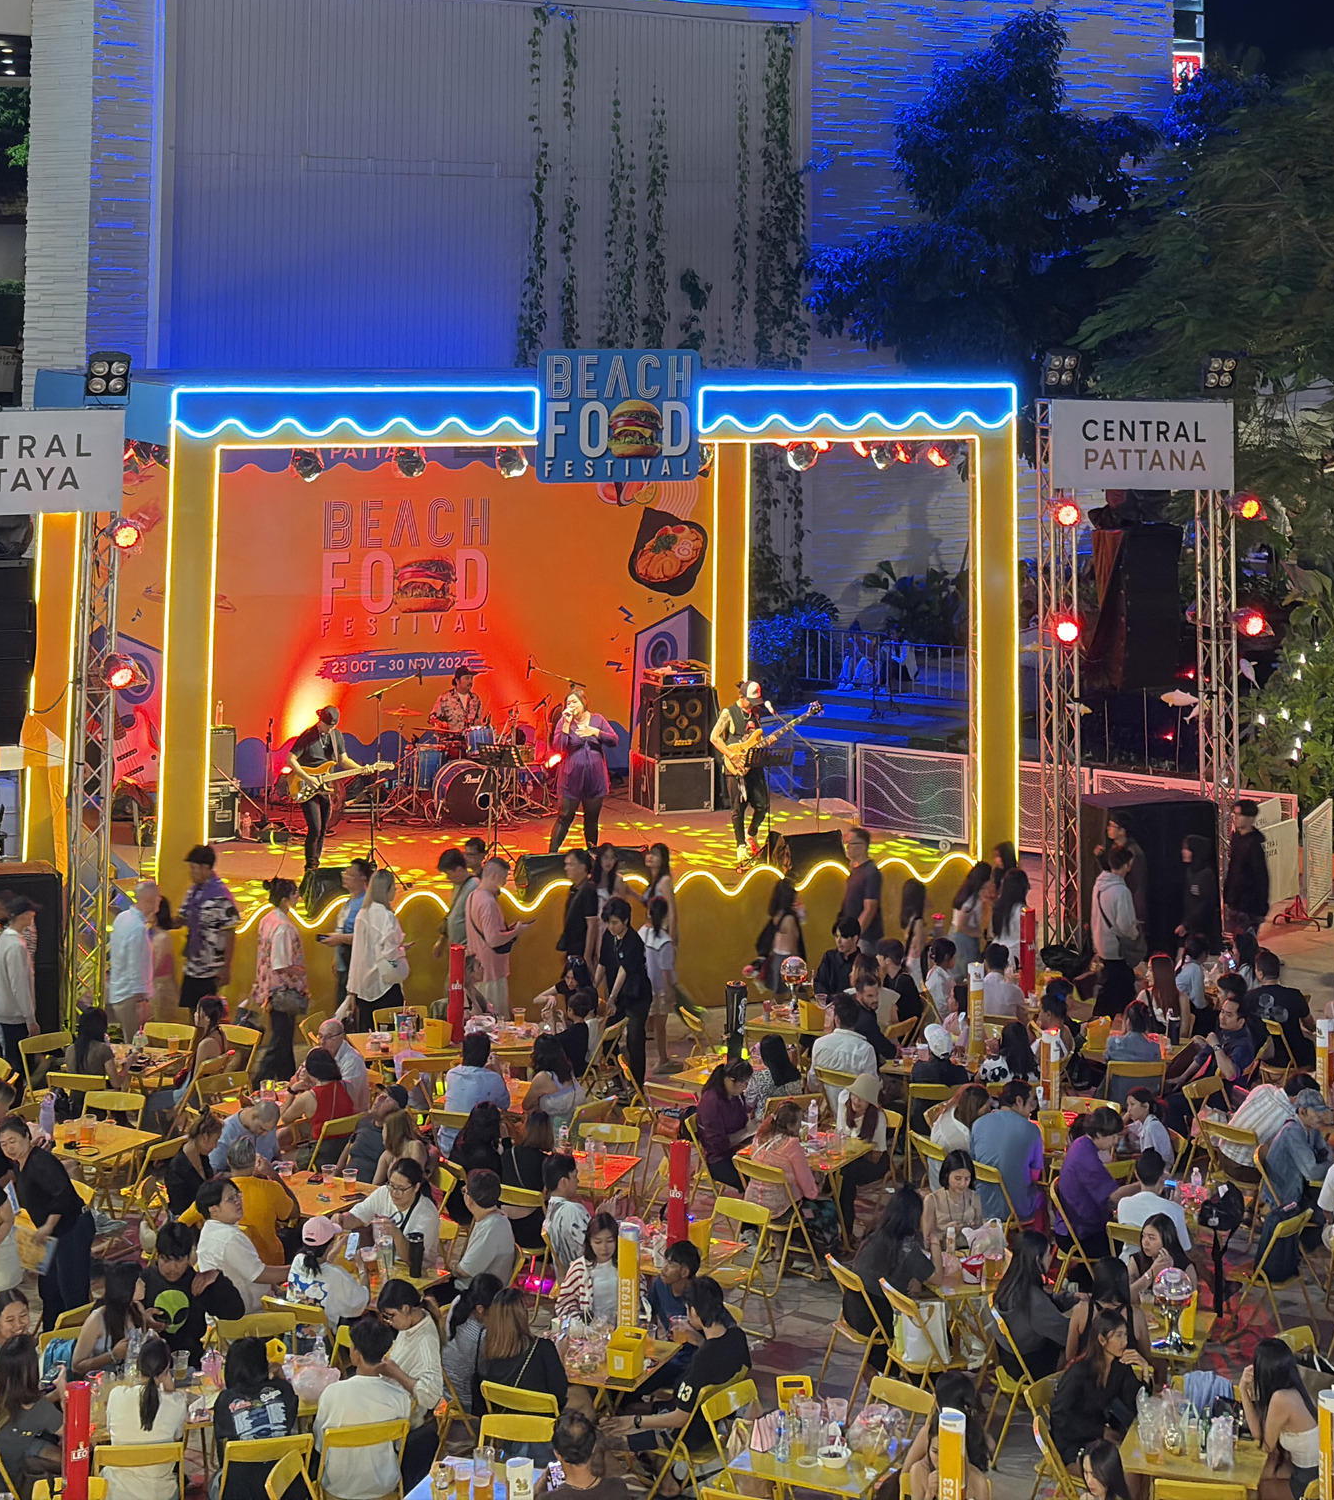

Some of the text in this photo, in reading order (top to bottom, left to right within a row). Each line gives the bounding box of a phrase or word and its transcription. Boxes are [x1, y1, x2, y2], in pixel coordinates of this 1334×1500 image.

[546, 354, 692, 399] BEACH
[545, 400, 690, 458] FOD
[1082, 419, 1206, 443] CENTRAL
[544, 458, 690, 478] FESTIVAL
[1084, 448, 1206, 472] PATTANA
[323, 497, 490, 550] BEACH
[321, 548, 489, 616] FOD
[320, 613, 488, 638] FESTIVAL
[331, 661, 347, 674] 23
[350, 660, 376, 673] OCT
[388, 658, 405, 672] 30
[408, 656, 436, 671] NOV
[438, 656, 470, 670] 2024
[621, 1278, 631, 1306] 1933
[71, 1449, 88, 1462] LEO
